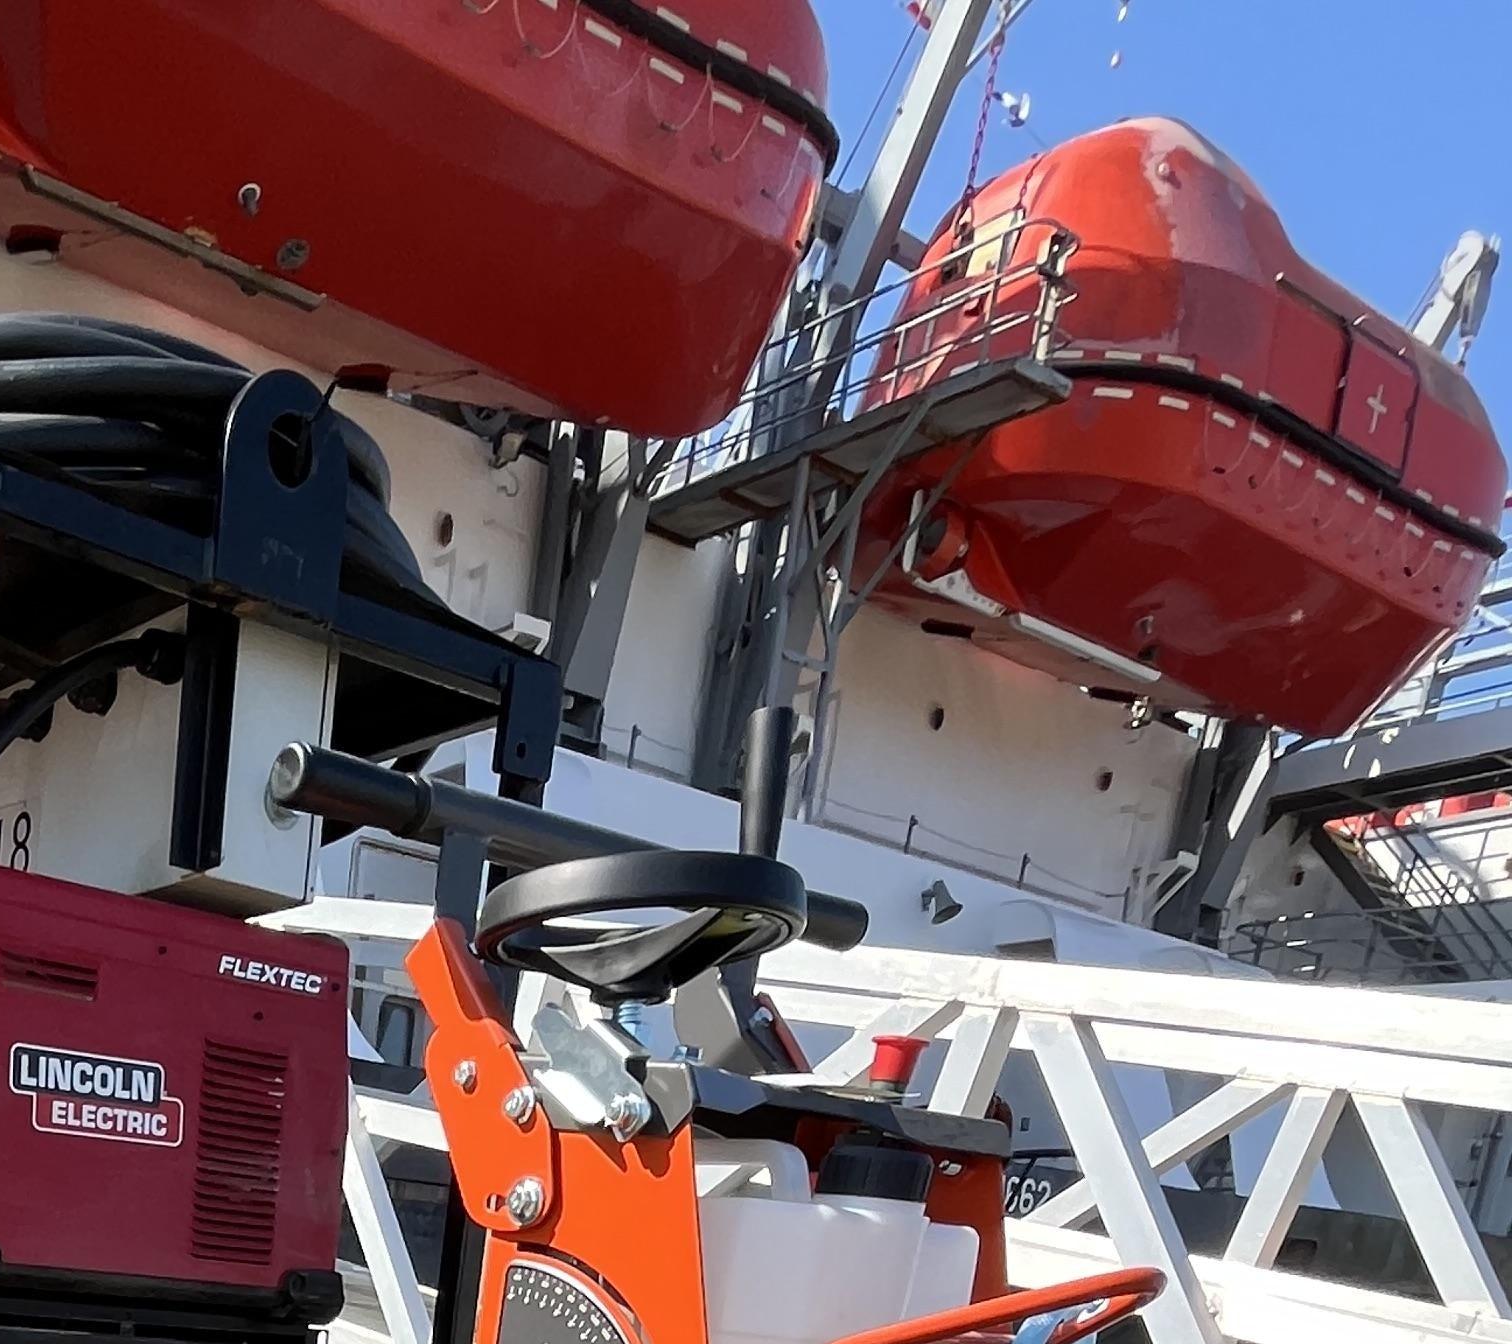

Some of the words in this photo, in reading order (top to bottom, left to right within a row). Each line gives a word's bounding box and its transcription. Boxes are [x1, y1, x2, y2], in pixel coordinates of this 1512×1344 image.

[218, 955, 323, 994] FLEXTEC
[19, 1053, 156, 1103] LINCOLN
[50, 1101, 168, 1138] ELECTRIC
